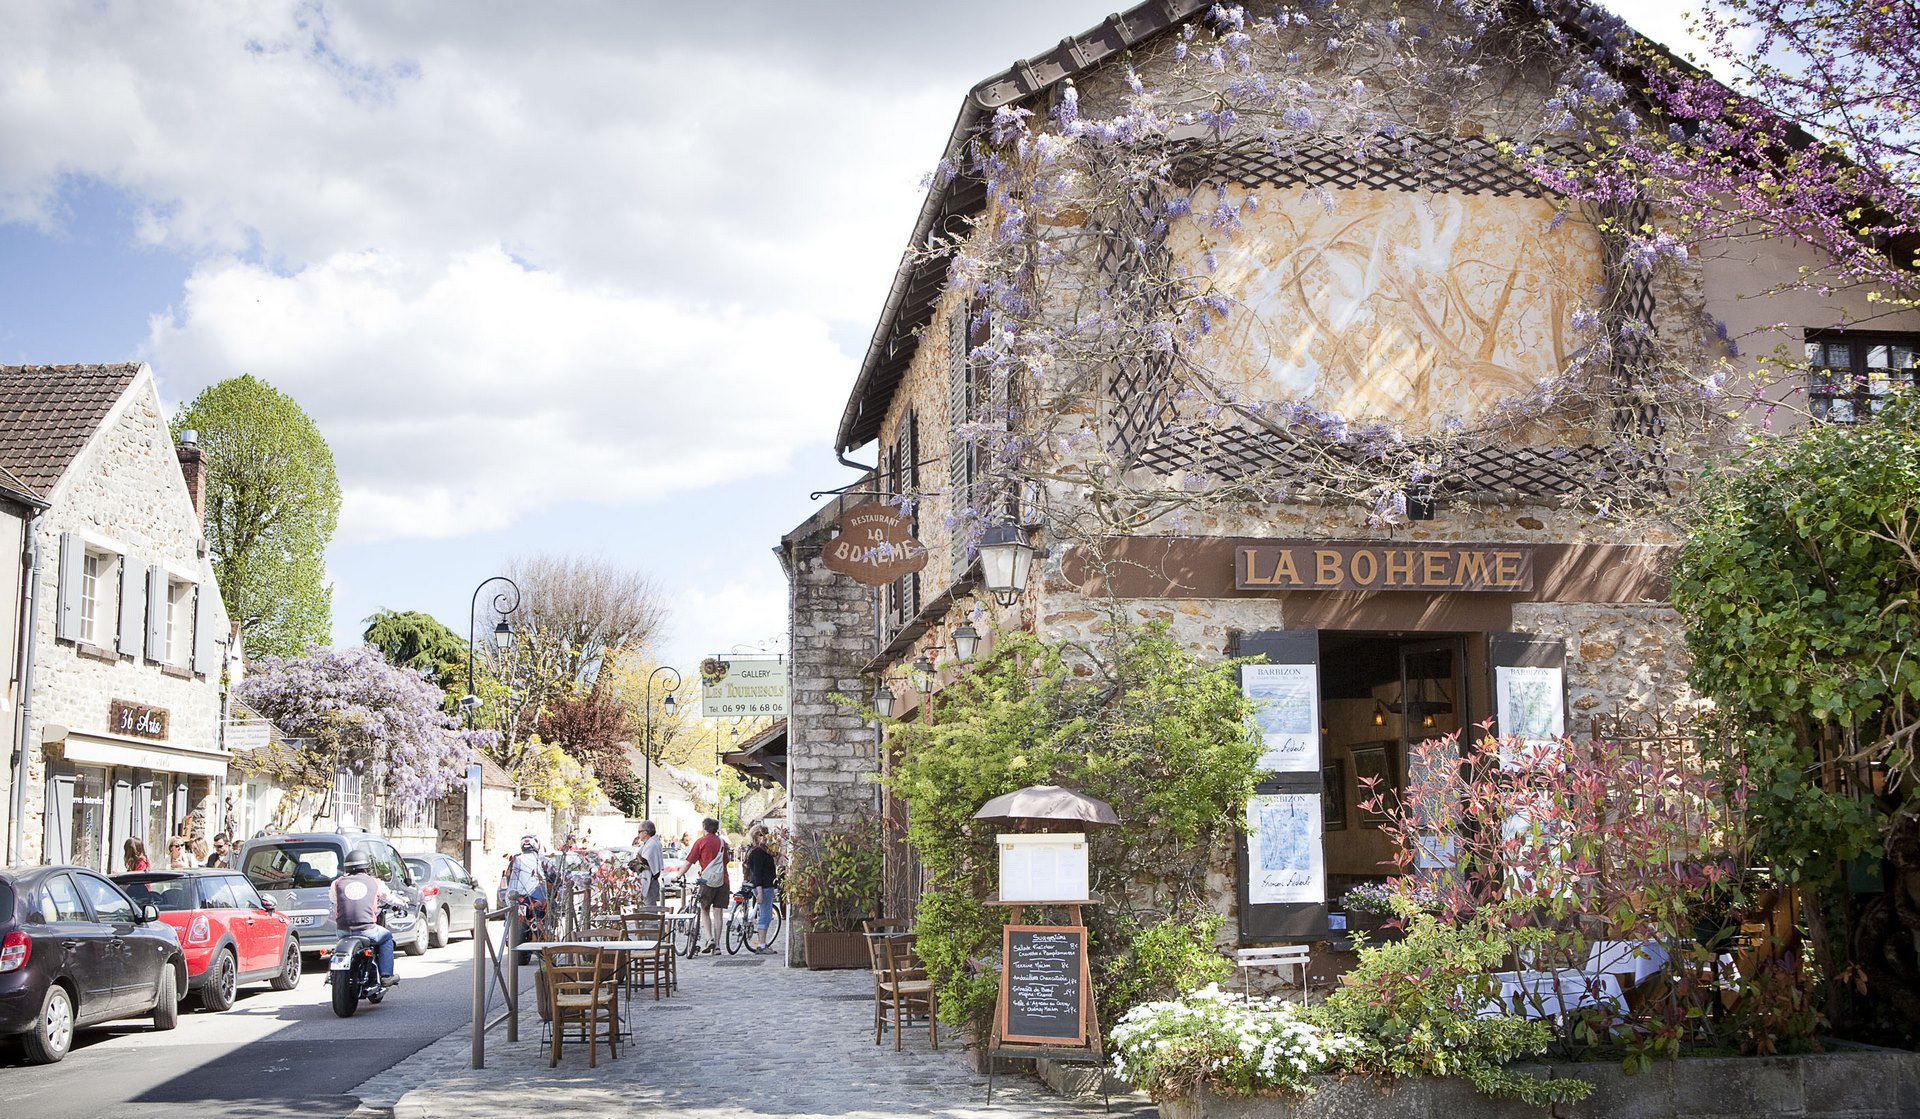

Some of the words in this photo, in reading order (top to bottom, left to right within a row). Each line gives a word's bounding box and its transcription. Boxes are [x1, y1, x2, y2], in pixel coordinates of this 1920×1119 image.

[850, 514, 900, 527] RESTAURANT
[1244, 549, 1304, 585] LA
[1314, 550, 1523, 586] BOHEME
[741, 670, 770, 678] GALLERY
[1257, 668, 1301, 676] BARBIZON
[722, 704, 733, 712] 06
[735, 704, 746, 712] 99
[749, 704, 757, 712] 16
[759, 703, 771, 712] 68
[772, 703, 783, 711] 06
[121, 708, 134, 729] 36
[136, 710, 161, 734] Arts
